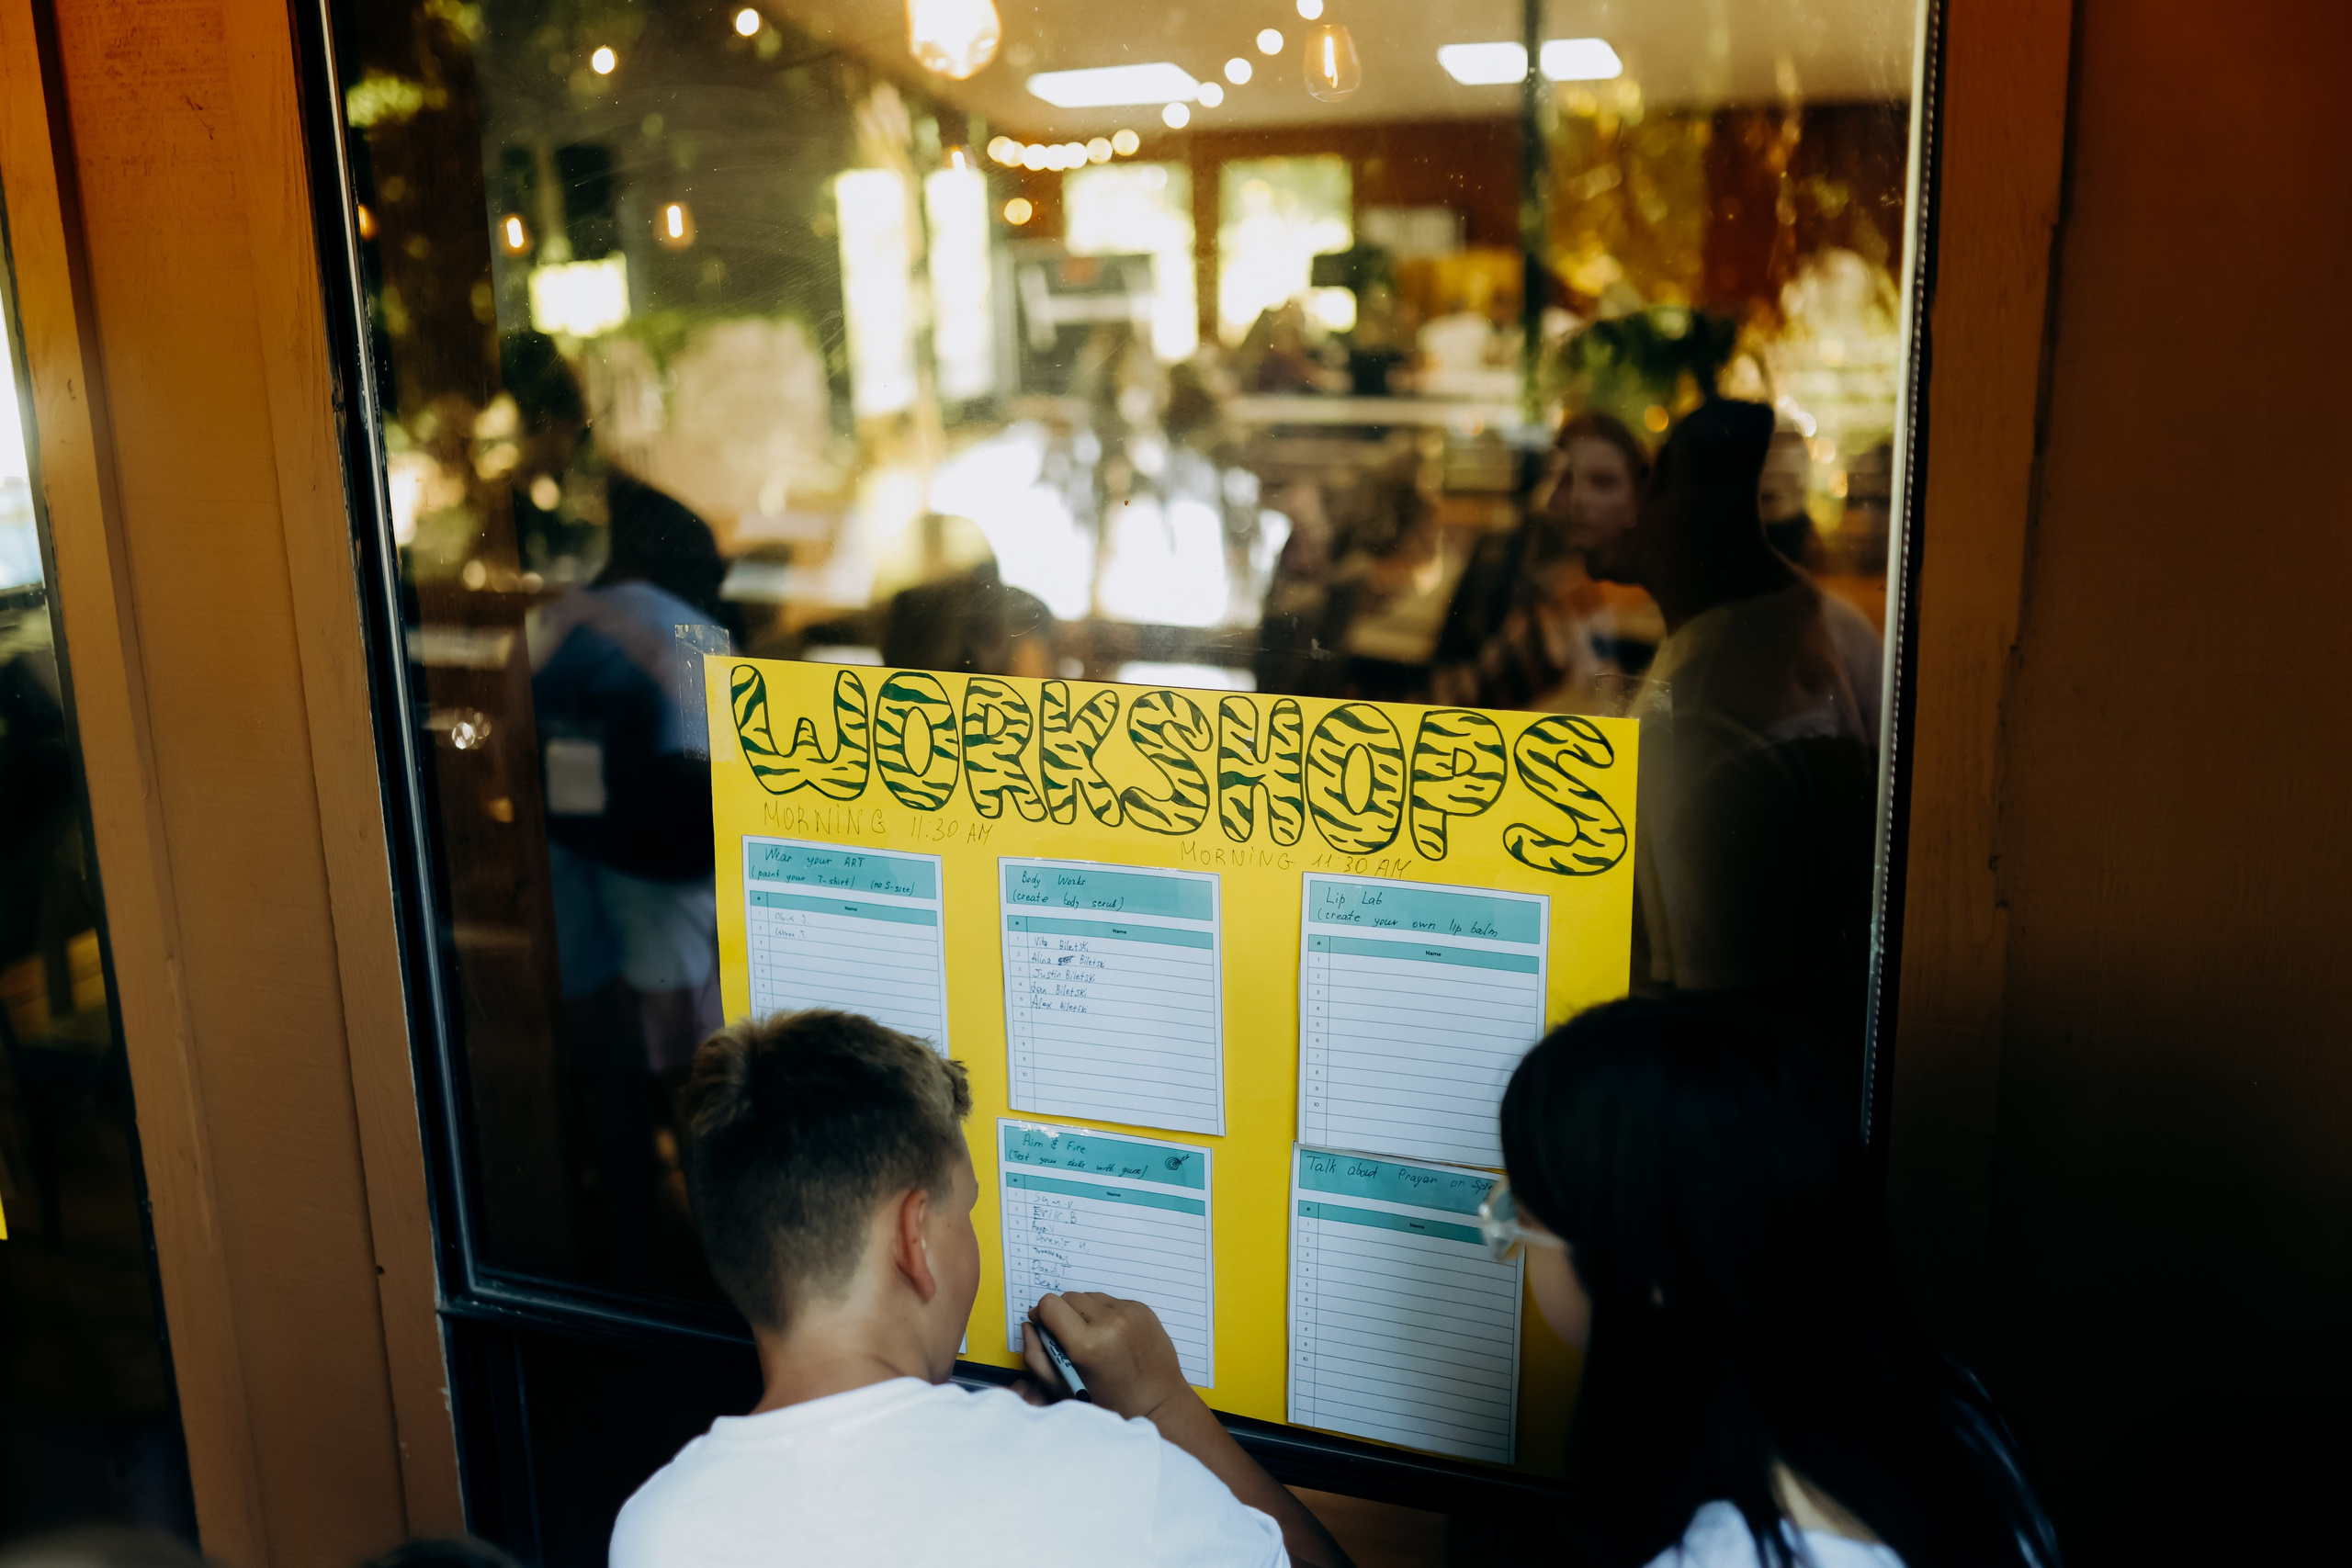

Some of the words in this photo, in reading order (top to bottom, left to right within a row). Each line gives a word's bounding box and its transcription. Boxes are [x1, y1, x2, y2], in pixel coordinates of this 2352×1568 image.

[730, 664, 1628, 876] WORKSHOPS
[763, 801, 886, 835] MORNING
[910, 816, 959, 841] 11:30
[967, 825, 993, 845] AM
[765, 848, 793, 863] Wear
[807, 857, 832, 868] your
[844, 857, 865, 868] ART
[1181, 840, 1295, 870] MORNING
[1312, 853, 1367, 874] 11:30
[1374, 858, 1411, 879] AM
[786, 874, 806, 883] your
[1022, 871, 1041, 888] Body
[1057, 874, 1086, 886] Works
[1012, 889, 1049, 904] (create
[1064, 892, 1080, 910] body
[1091, 897, 1125, 911] scrub)
[1326, 886, 1346, 907] Lip
[1362, 891, 1383, 906] Lab
[1317, 908, 1361, 922] (create
[1373, 917, 1398, 928] your
[1412, 920, 1436, 930] own
[1449, 919, 1463, 936] lip
[1470, 921, 1498, 938] balm
[1032, 968, 1061, 980] Justin
[1023, 1133, 1044, 1148] Aim
[1067, 1140, 1086, 1155] Fire
[1008, 1149, 1031, 1161] (Test
[1039, 1156, 1057, 1165] your
[1096, 1163, 1114, 1173] with
[1306, 1156, 1336, 1173] Talk
[1347, 1163, 1379, 1179] about
[1397, 1168, 1438, 1188] Prayer
